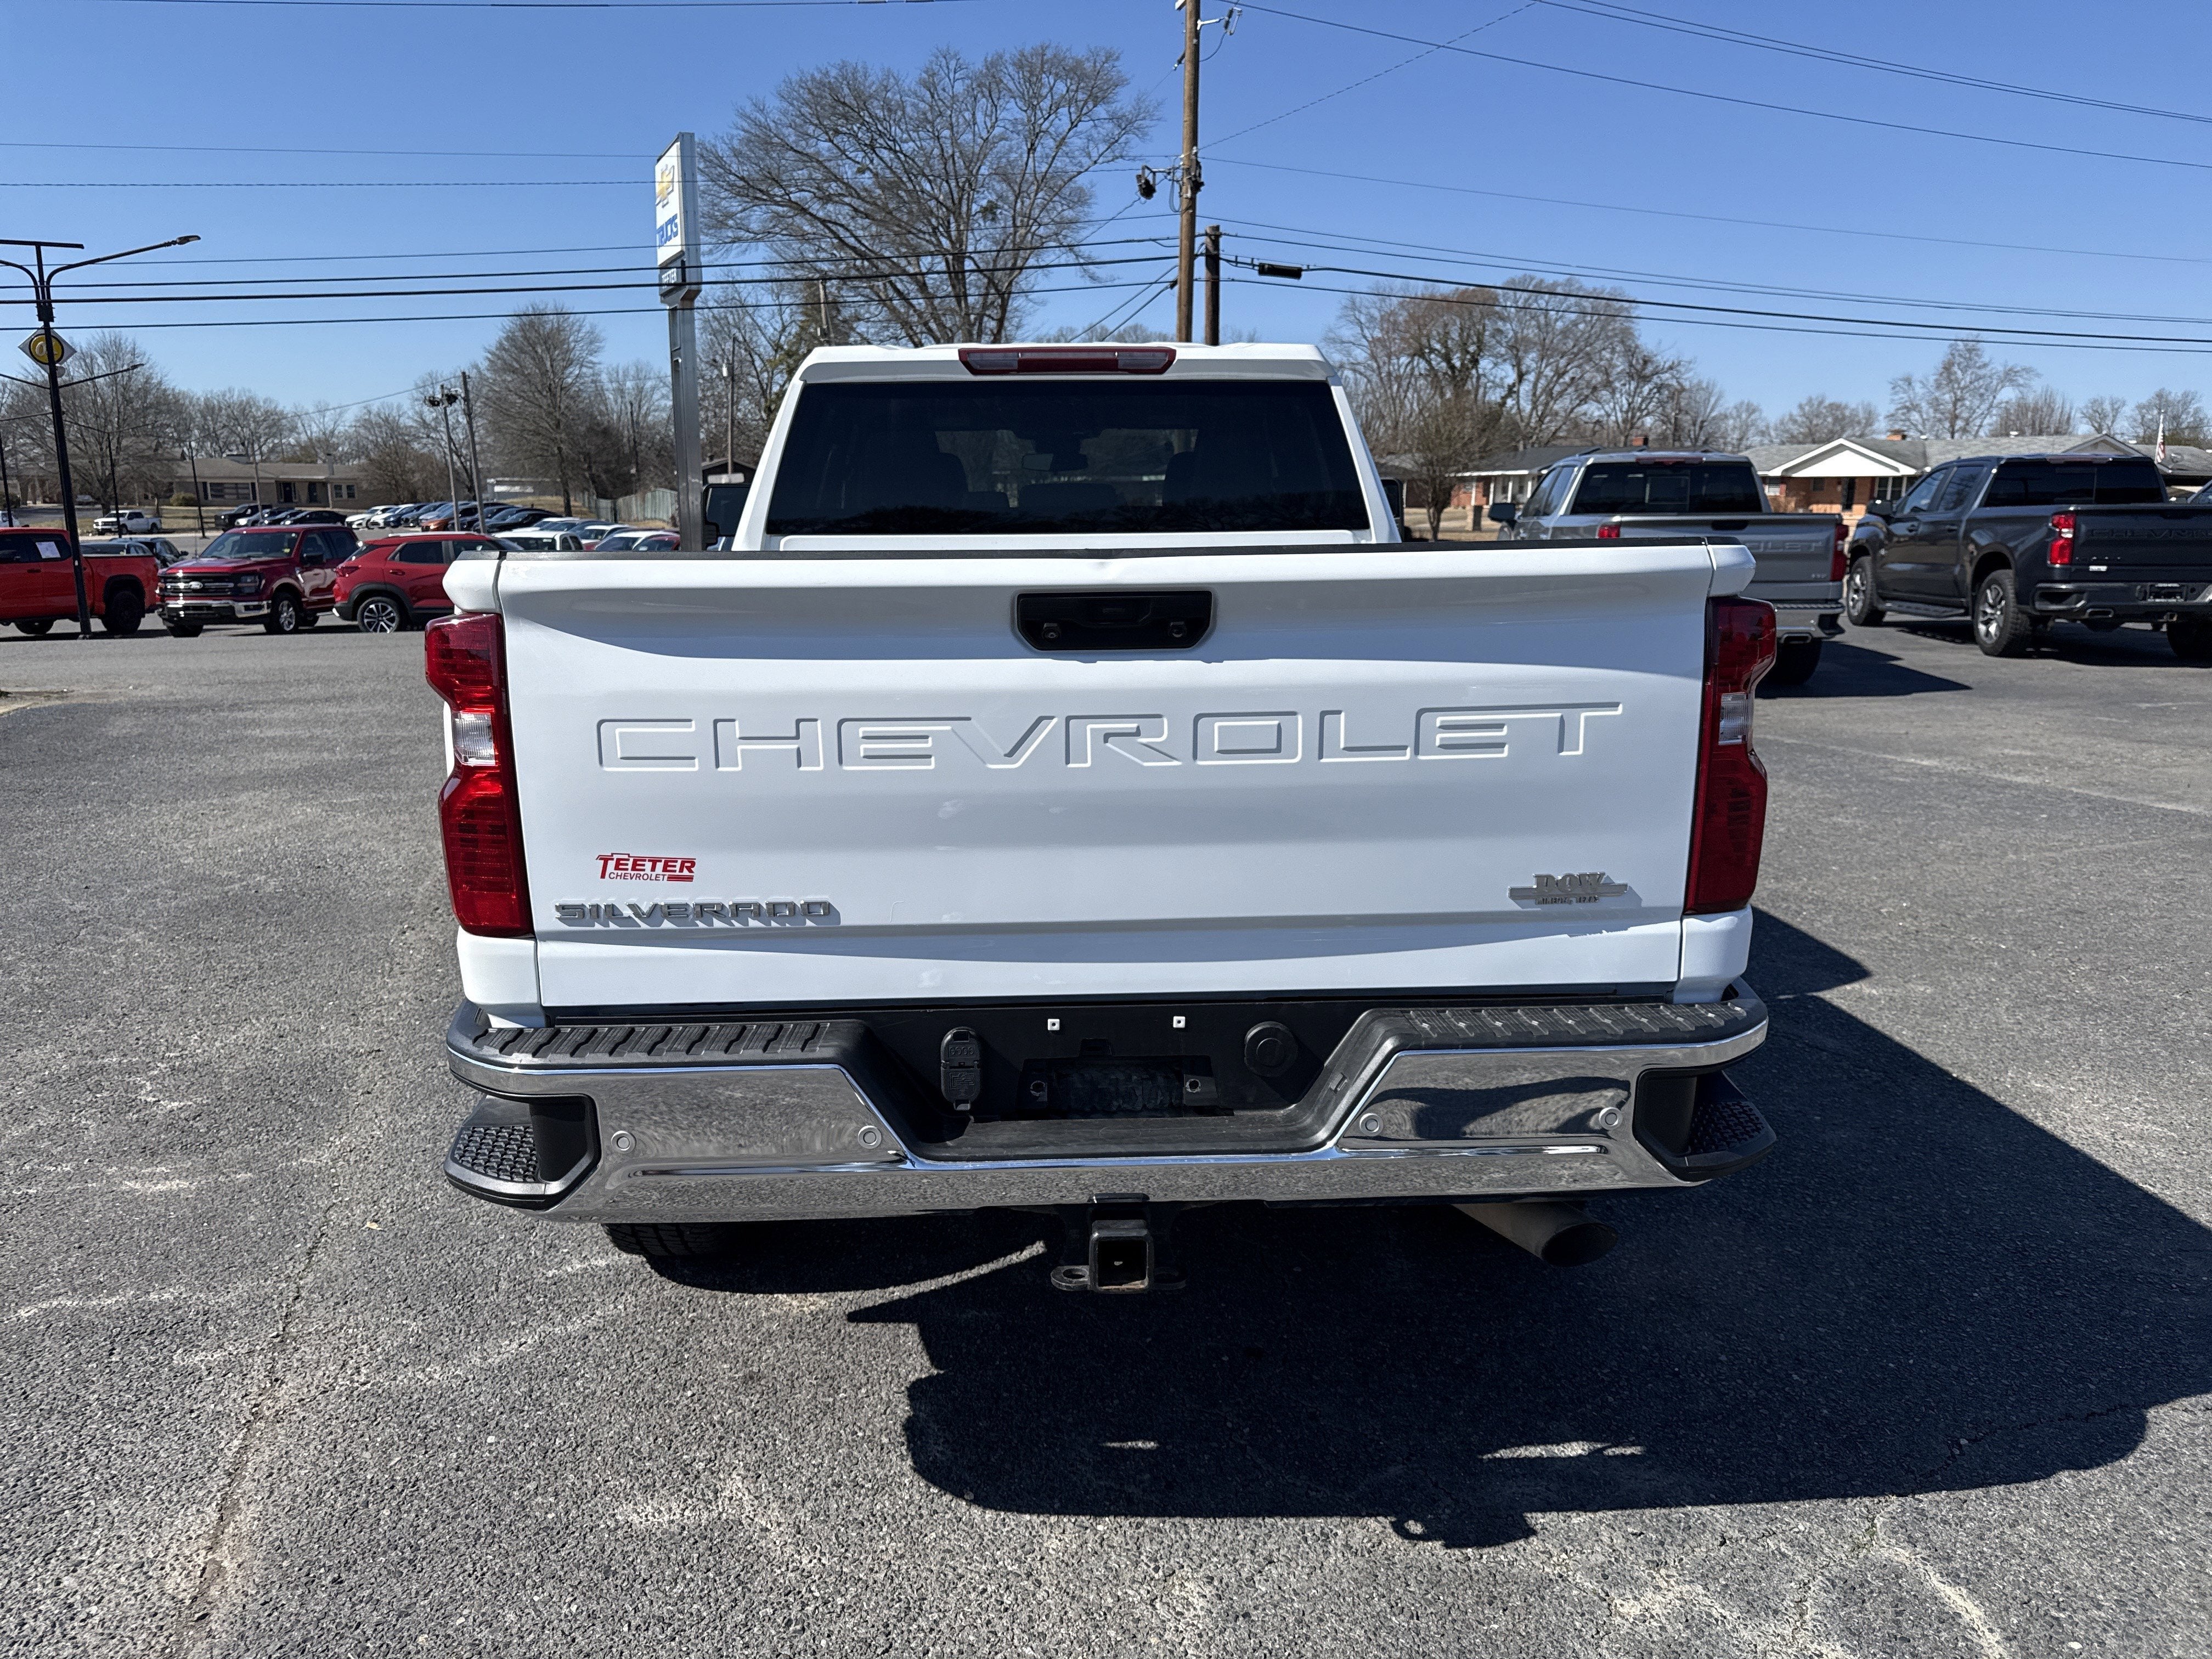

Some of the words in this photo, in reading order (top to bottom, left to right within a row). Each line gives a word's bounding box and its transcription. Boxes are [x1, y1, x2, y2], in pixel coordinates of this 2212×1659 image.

[597, 702, 1623, 771] CHEVROLET
[597, 857, 696, 879] TEETER
[608, 871, 667, 882] CHEVROLET
[1533, 872, 1605, 893] DOW
[555, 900, 830, 919] SILVERADO
